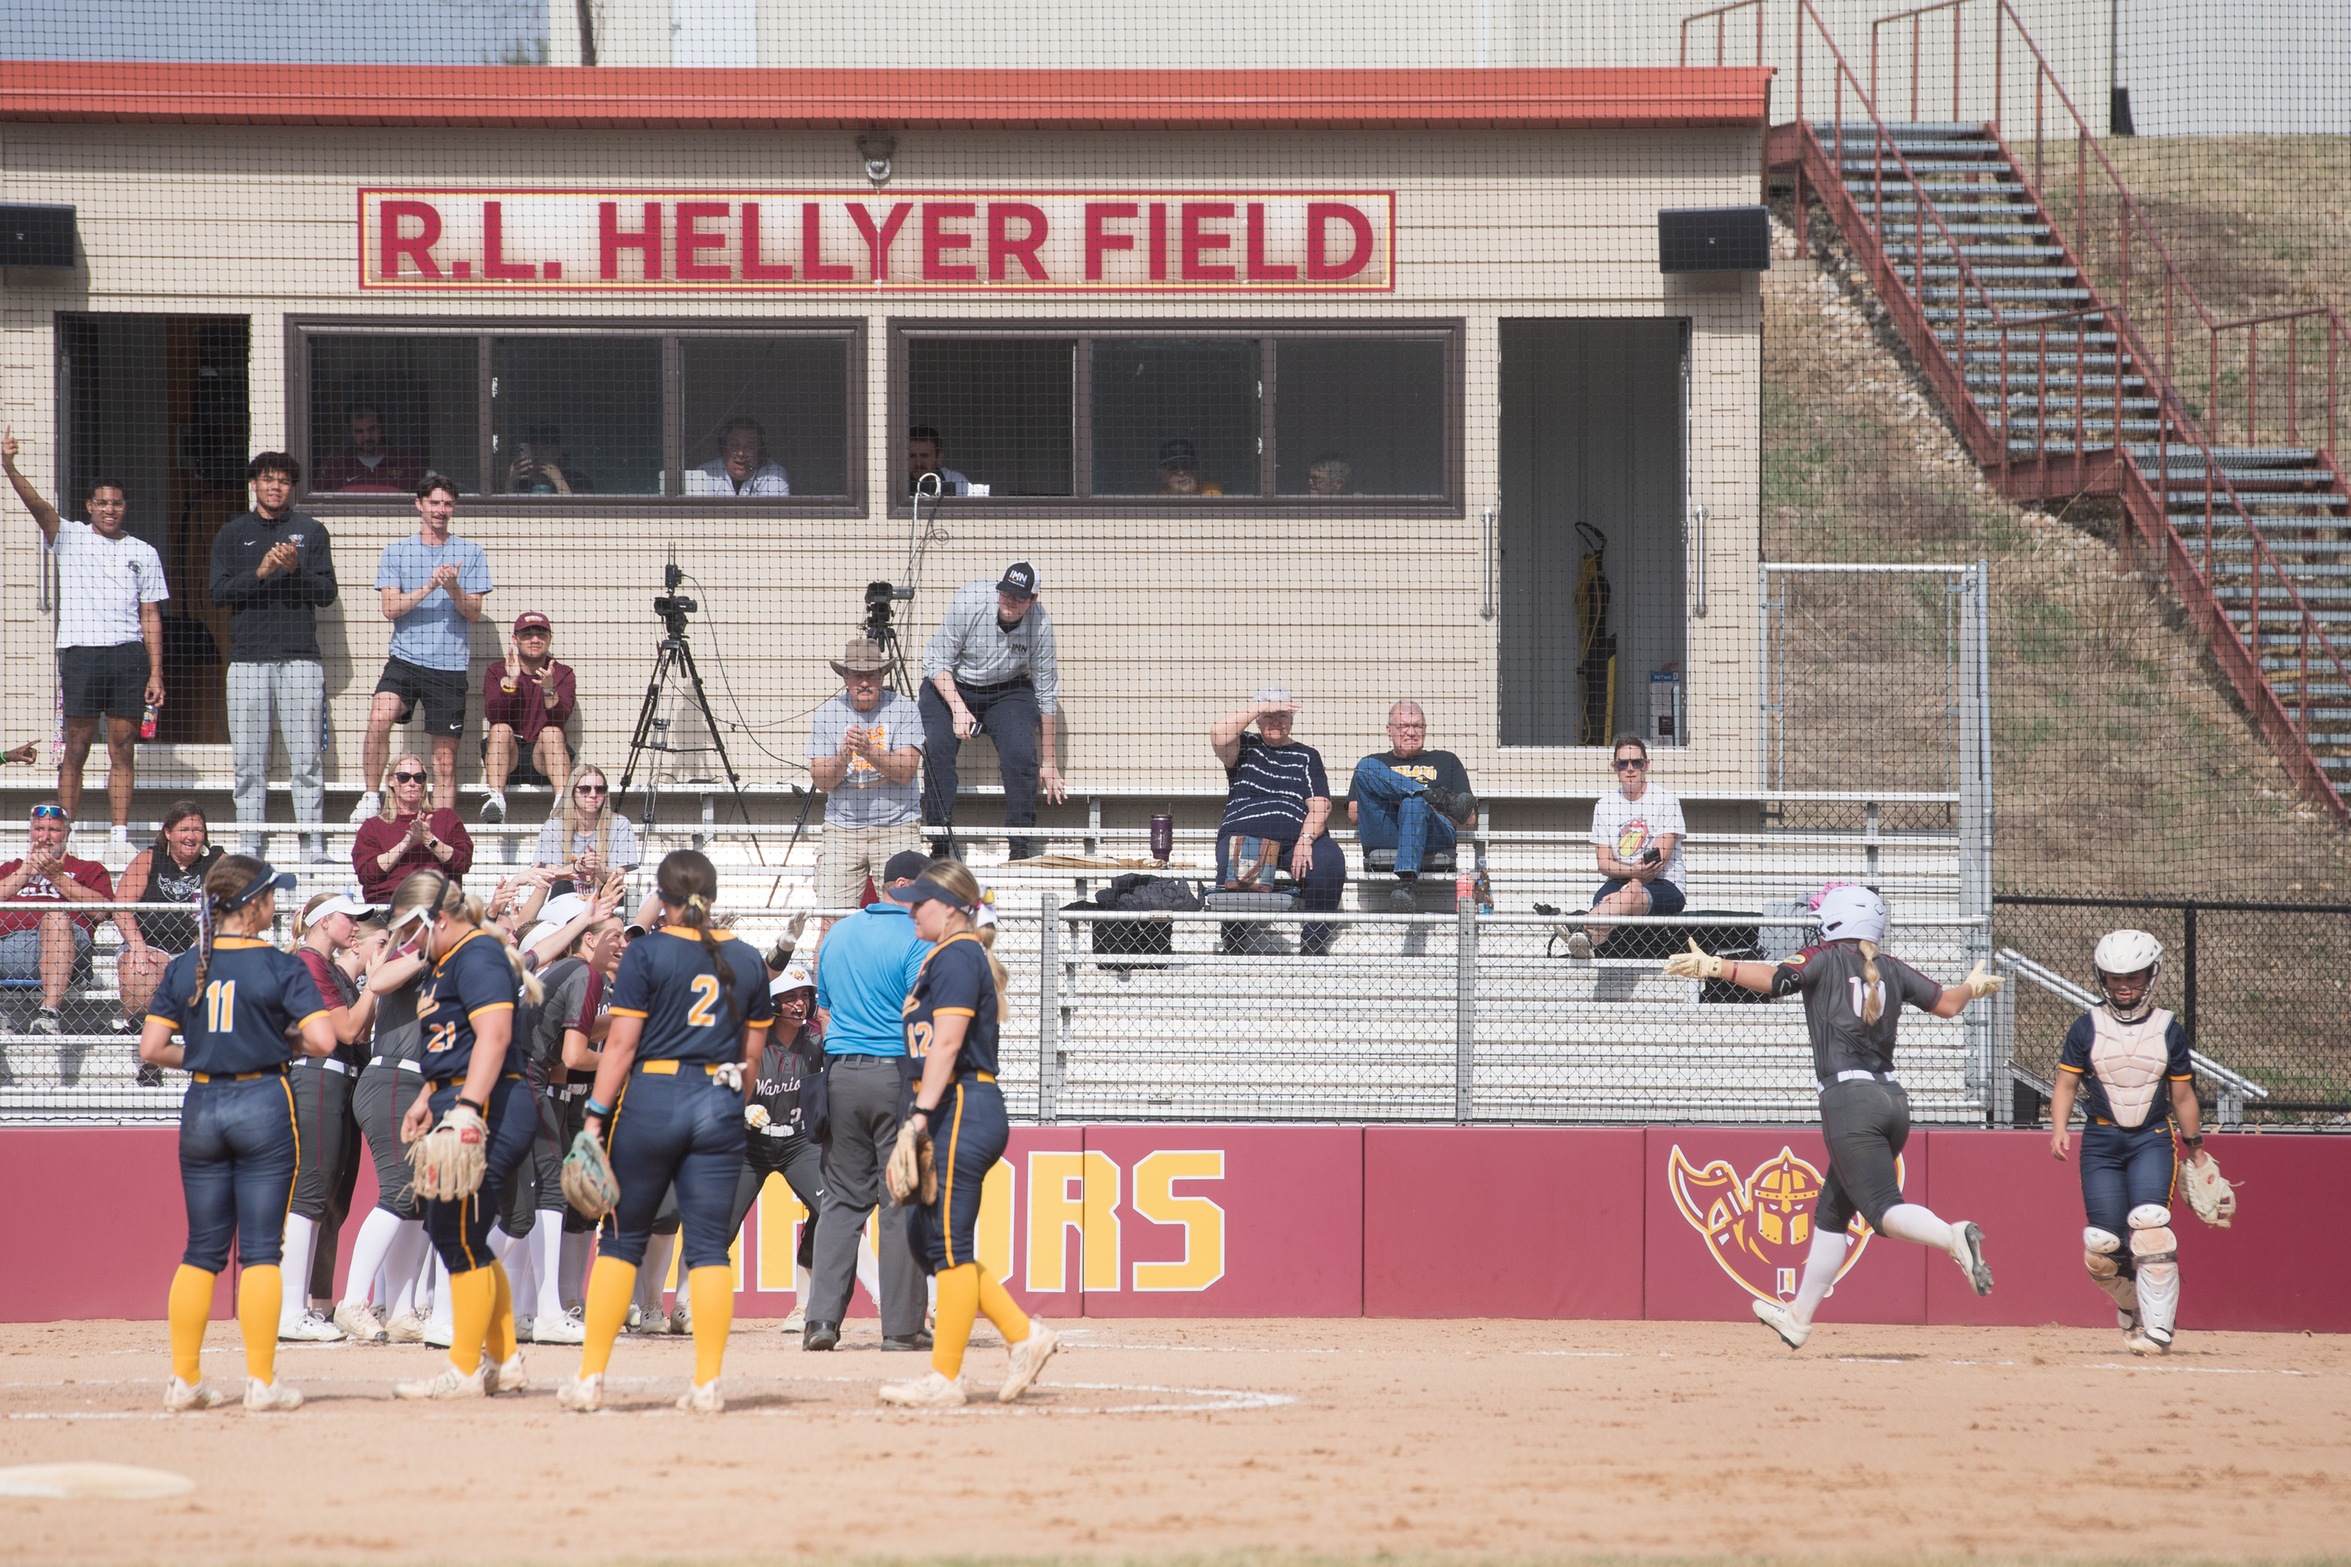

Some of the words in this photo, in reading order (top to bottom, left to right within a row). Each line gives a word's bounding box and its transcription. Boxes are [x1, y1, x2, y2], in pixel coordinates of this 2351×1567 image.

[381, 201, 561, 279] R.L.
[600, 202, 1050, 280] HELLYER
[1085, 203, 1373, 280] FIELD
[1009, 570, 1027, 584] IMN
[206, 980, 235, 1032] 11
[688, 974, 719, 1026] 2
[427, 1020, 456, 1053] 21
[907, 1020, 934, 1058] 12
